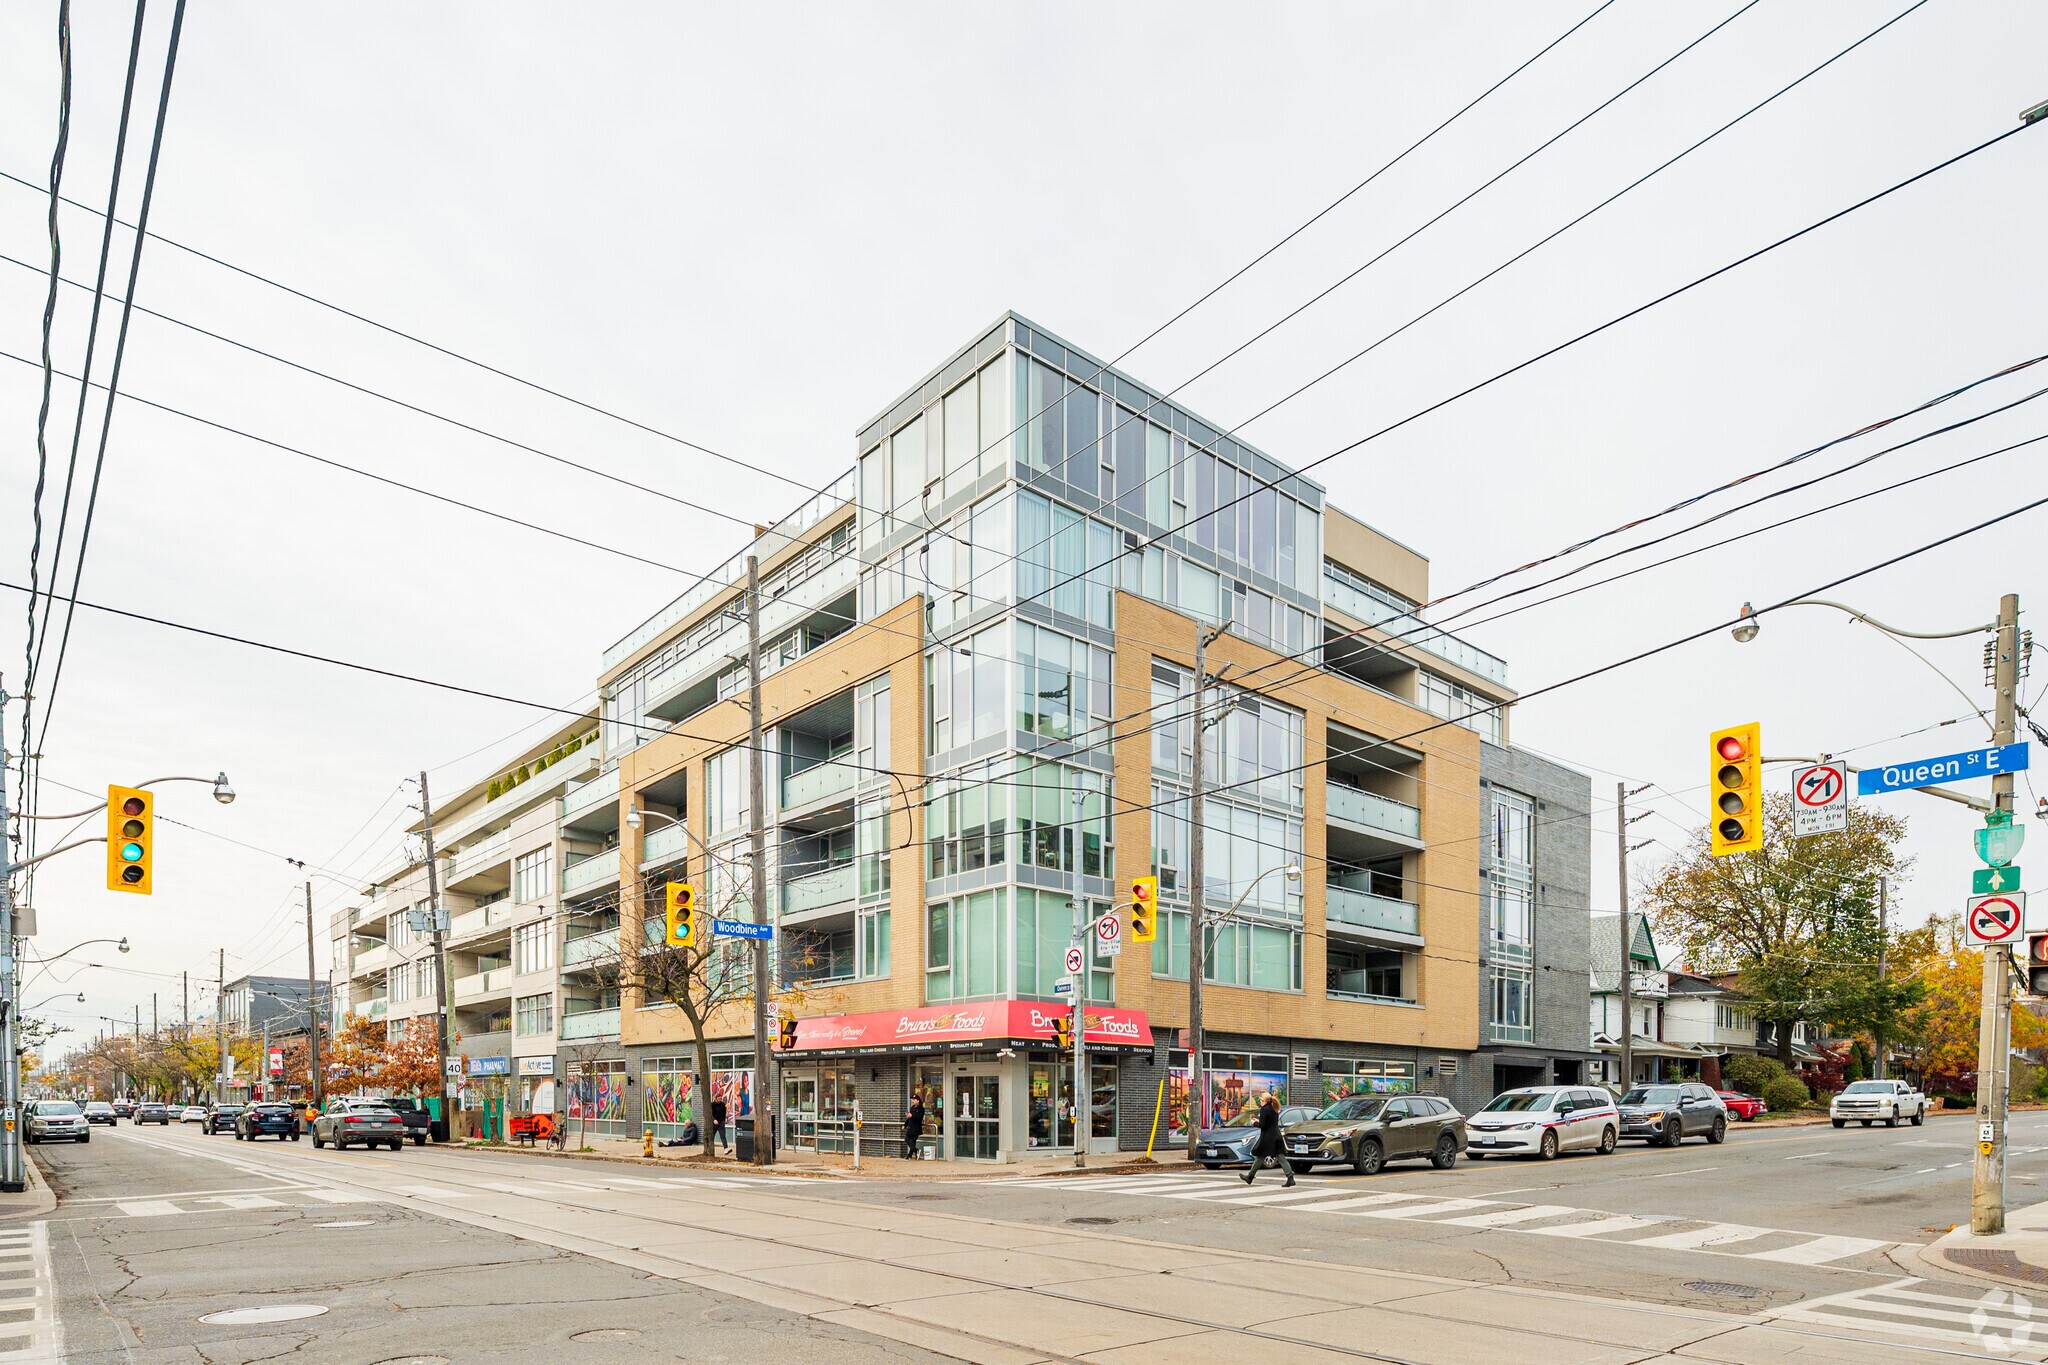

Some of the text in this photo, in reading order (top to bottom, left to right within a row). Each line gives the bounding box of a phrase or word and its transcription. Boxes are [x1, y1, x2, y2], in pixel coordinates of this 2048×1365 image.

[1883, 749, 2000, 787] Queen St E
[717, 921, 758, 936] Woodbine
[896, 1016, 935, 1034] Bruno's
[952, 1011, 986, 1030] Foods
[1101, 1015, 1139, 1034] Foods
[447, 1064, 461, 1073] 40
